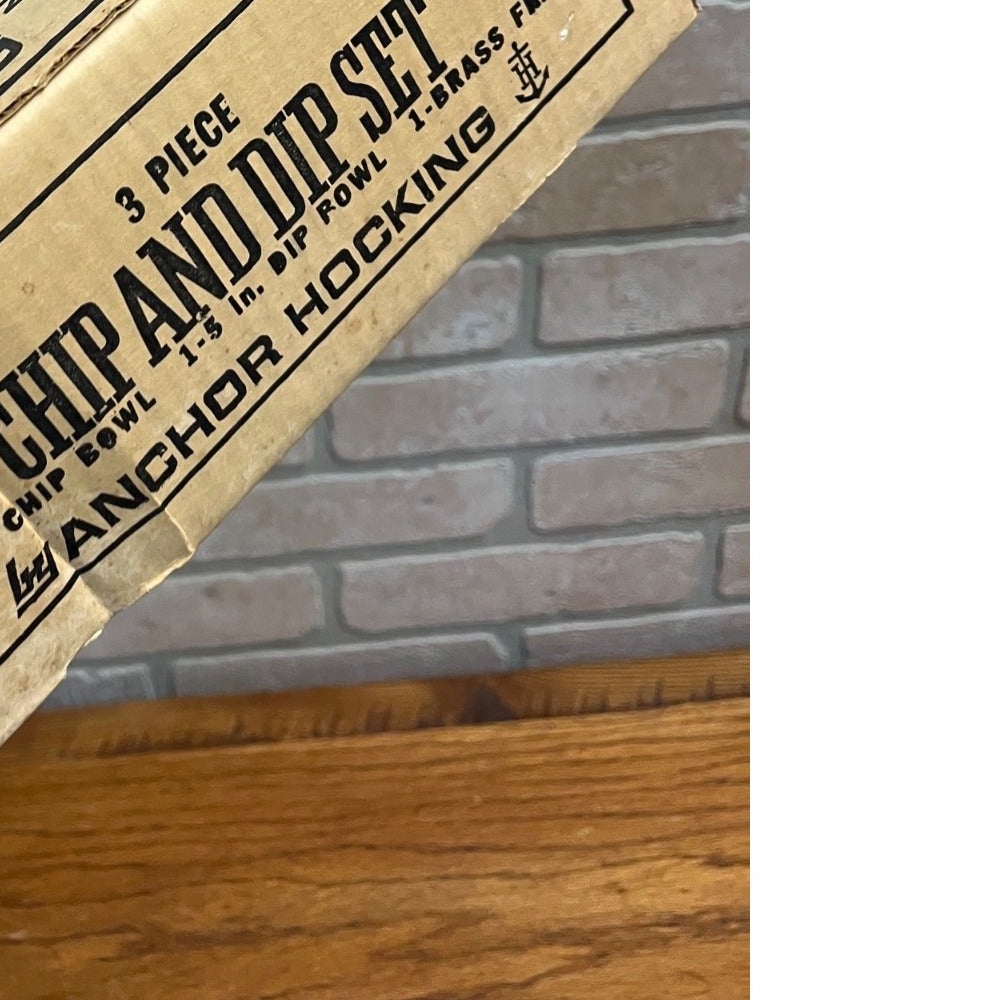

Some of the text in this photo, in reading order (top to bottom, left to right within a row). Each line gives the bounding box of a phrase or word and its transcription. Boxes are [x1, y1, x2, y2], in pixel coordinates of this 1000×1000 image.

[2, 467, 66, 532] CHIP
[75, 390, 157, 468] BOWL
[267, 224, 308, 276] DIP
[407, 26, 505, 132] 1-BRASS
[60, 104, 497, 563] ANCHOR HOCKING
[113, 182, 263, 368] AND
[227, 82, 350, 241] DIP
[115, 92, 243, 224] 3 PIECE
